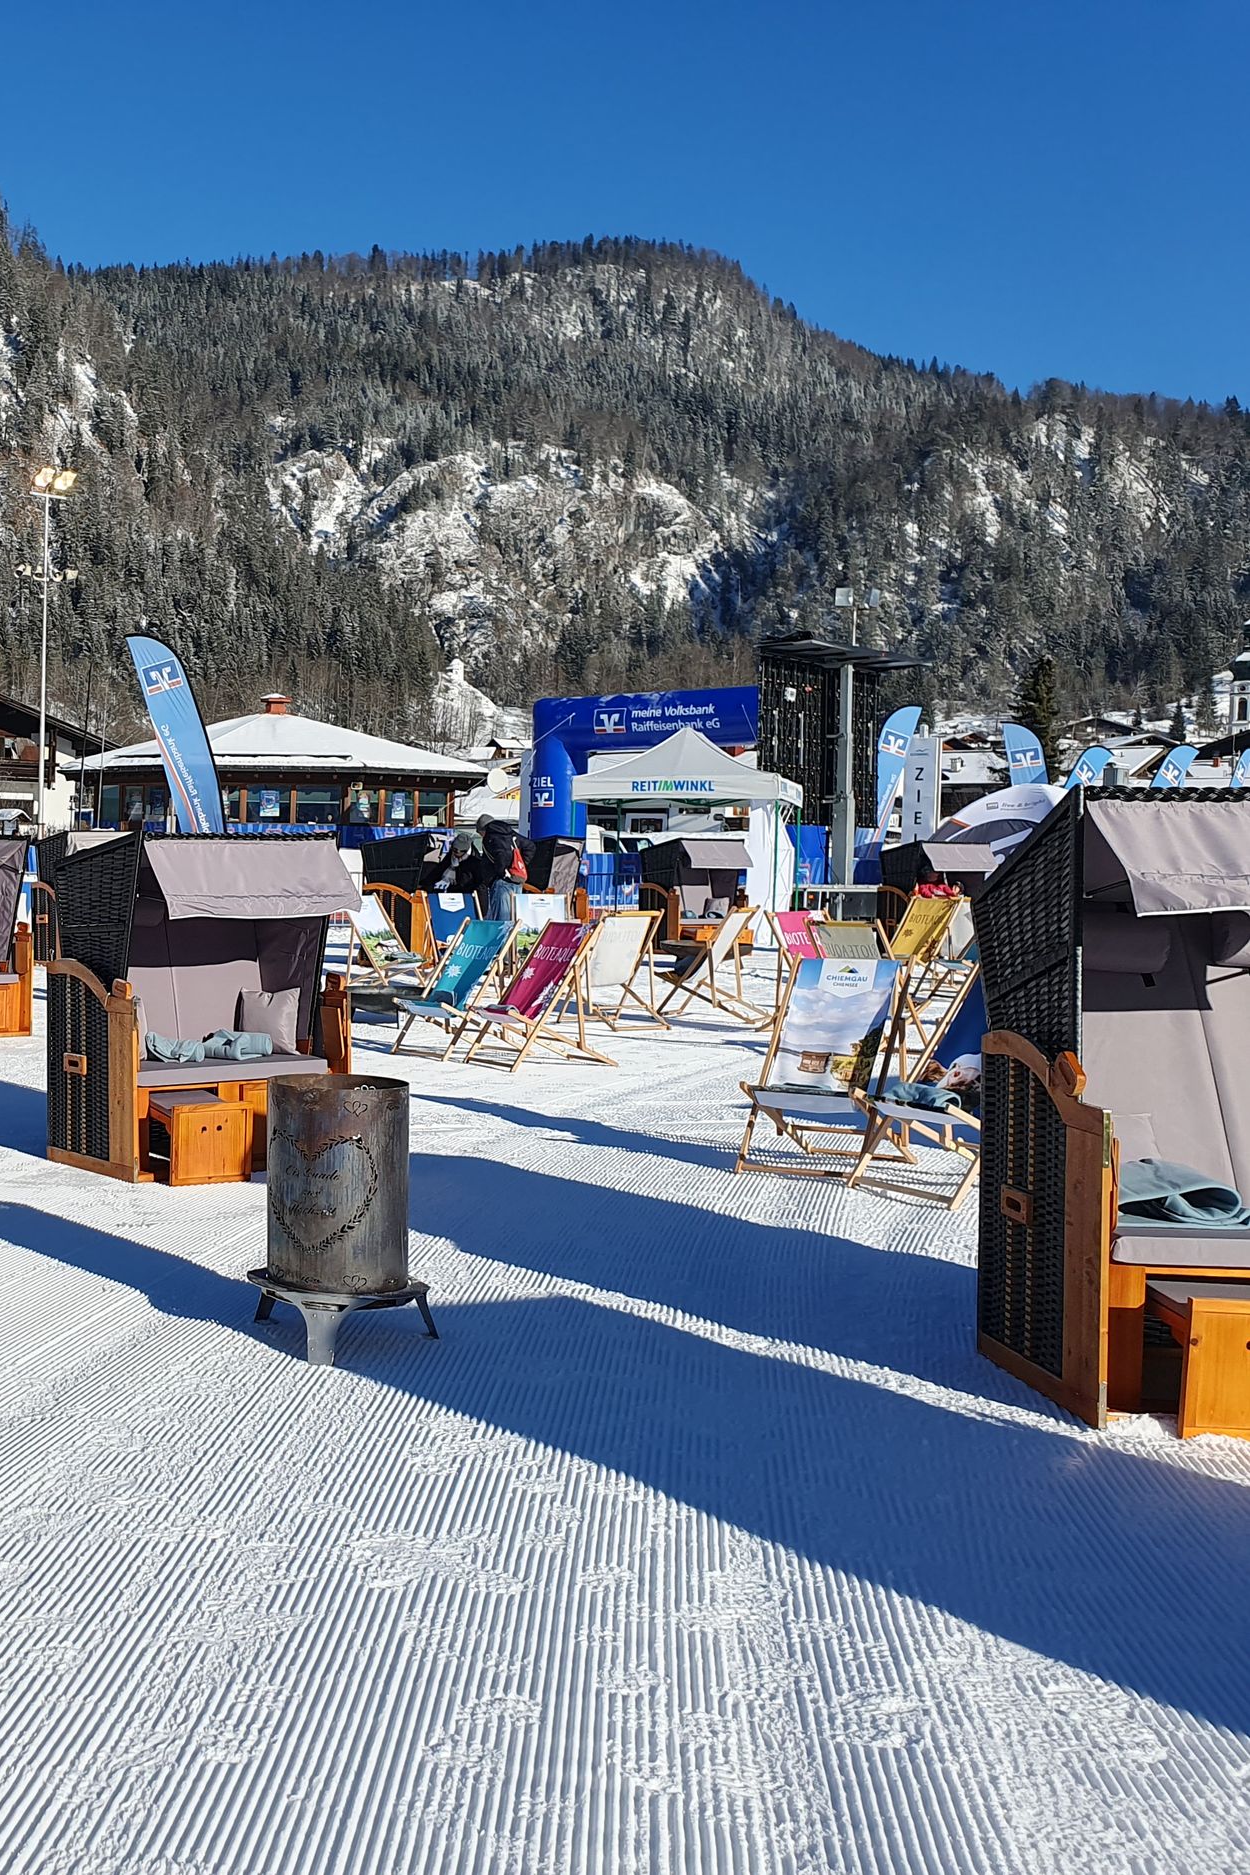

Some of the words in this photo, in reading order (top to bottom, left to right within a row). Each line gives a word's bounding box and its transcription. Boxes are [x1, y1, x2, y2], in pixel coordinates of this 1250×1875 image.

[631, 707, 663, 718] meine
[664, 703, 715, 717] Volksbank
[631, 718, 704, 732] Raiffeisenbank
[705, 718, 720, 729] eG
[532, 776, 554, 788] ZIEL
[631, 780, 715, 792] REITIMWINKL
[826, 974, 868, 982] CHIEMGAU
